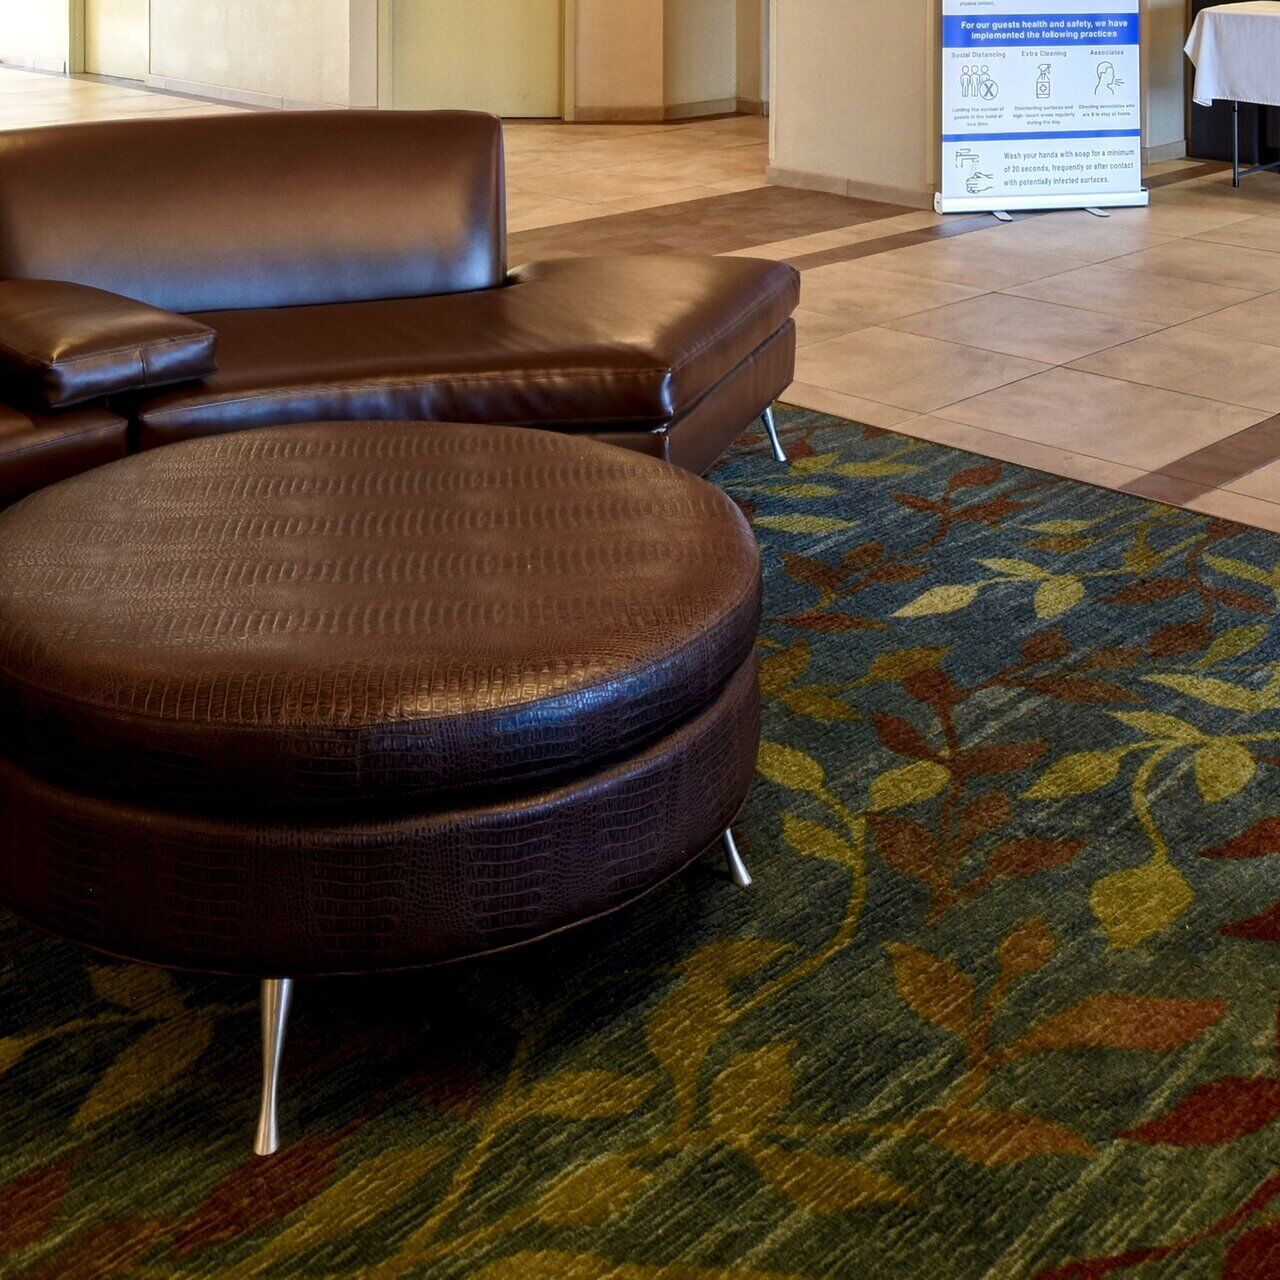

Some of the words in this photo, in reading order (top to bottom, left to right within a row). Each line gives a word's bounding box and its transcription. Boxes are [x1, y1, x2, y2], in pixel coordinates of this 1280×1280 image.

[961, 21, 974, 29] For
[992, 21, 1020, 31] guests
[1022, 20, 1048, 28] health
[1049, 20, 1064, 28] and
[1066, 19, 1093, 29] safety,
[1108, 19, 1128, 27] have
[971, 31, 1025, 40] implemented
[1026, 31, 1039, 39] the
[1042, 30, 1077, 40] following
[1080, 29, 1117, 39] practices
[972, 51, 1006, 59] Distancing
[1004, 151, 1021, 160] Wash
[1022, 152, 1037, 161] your
[1038, 150, 1059, 159] hands
[1060, 150, 1073, 158] with
[1074, 150, 1090, 160] soap
[1091, 149, 1101, 158] for
[1107, 148, 1135, 157] minimum
[1004, 165, 1011, 173] of
[1012, 165, 1020, 173] 20
[1021, 164, 1051, 174] seconds,
[1052, 163, 1084, 173] frequently
[1094, 162, 1108, 170] after
[1110, 161, 1134, 170] contact
[1004, 179, 1017, 187] with
[1019, 178, 1052, 187] potentially
[1053, 177, 1079, 185] infected
[1080, 176, 1109, 185] surfaces.
